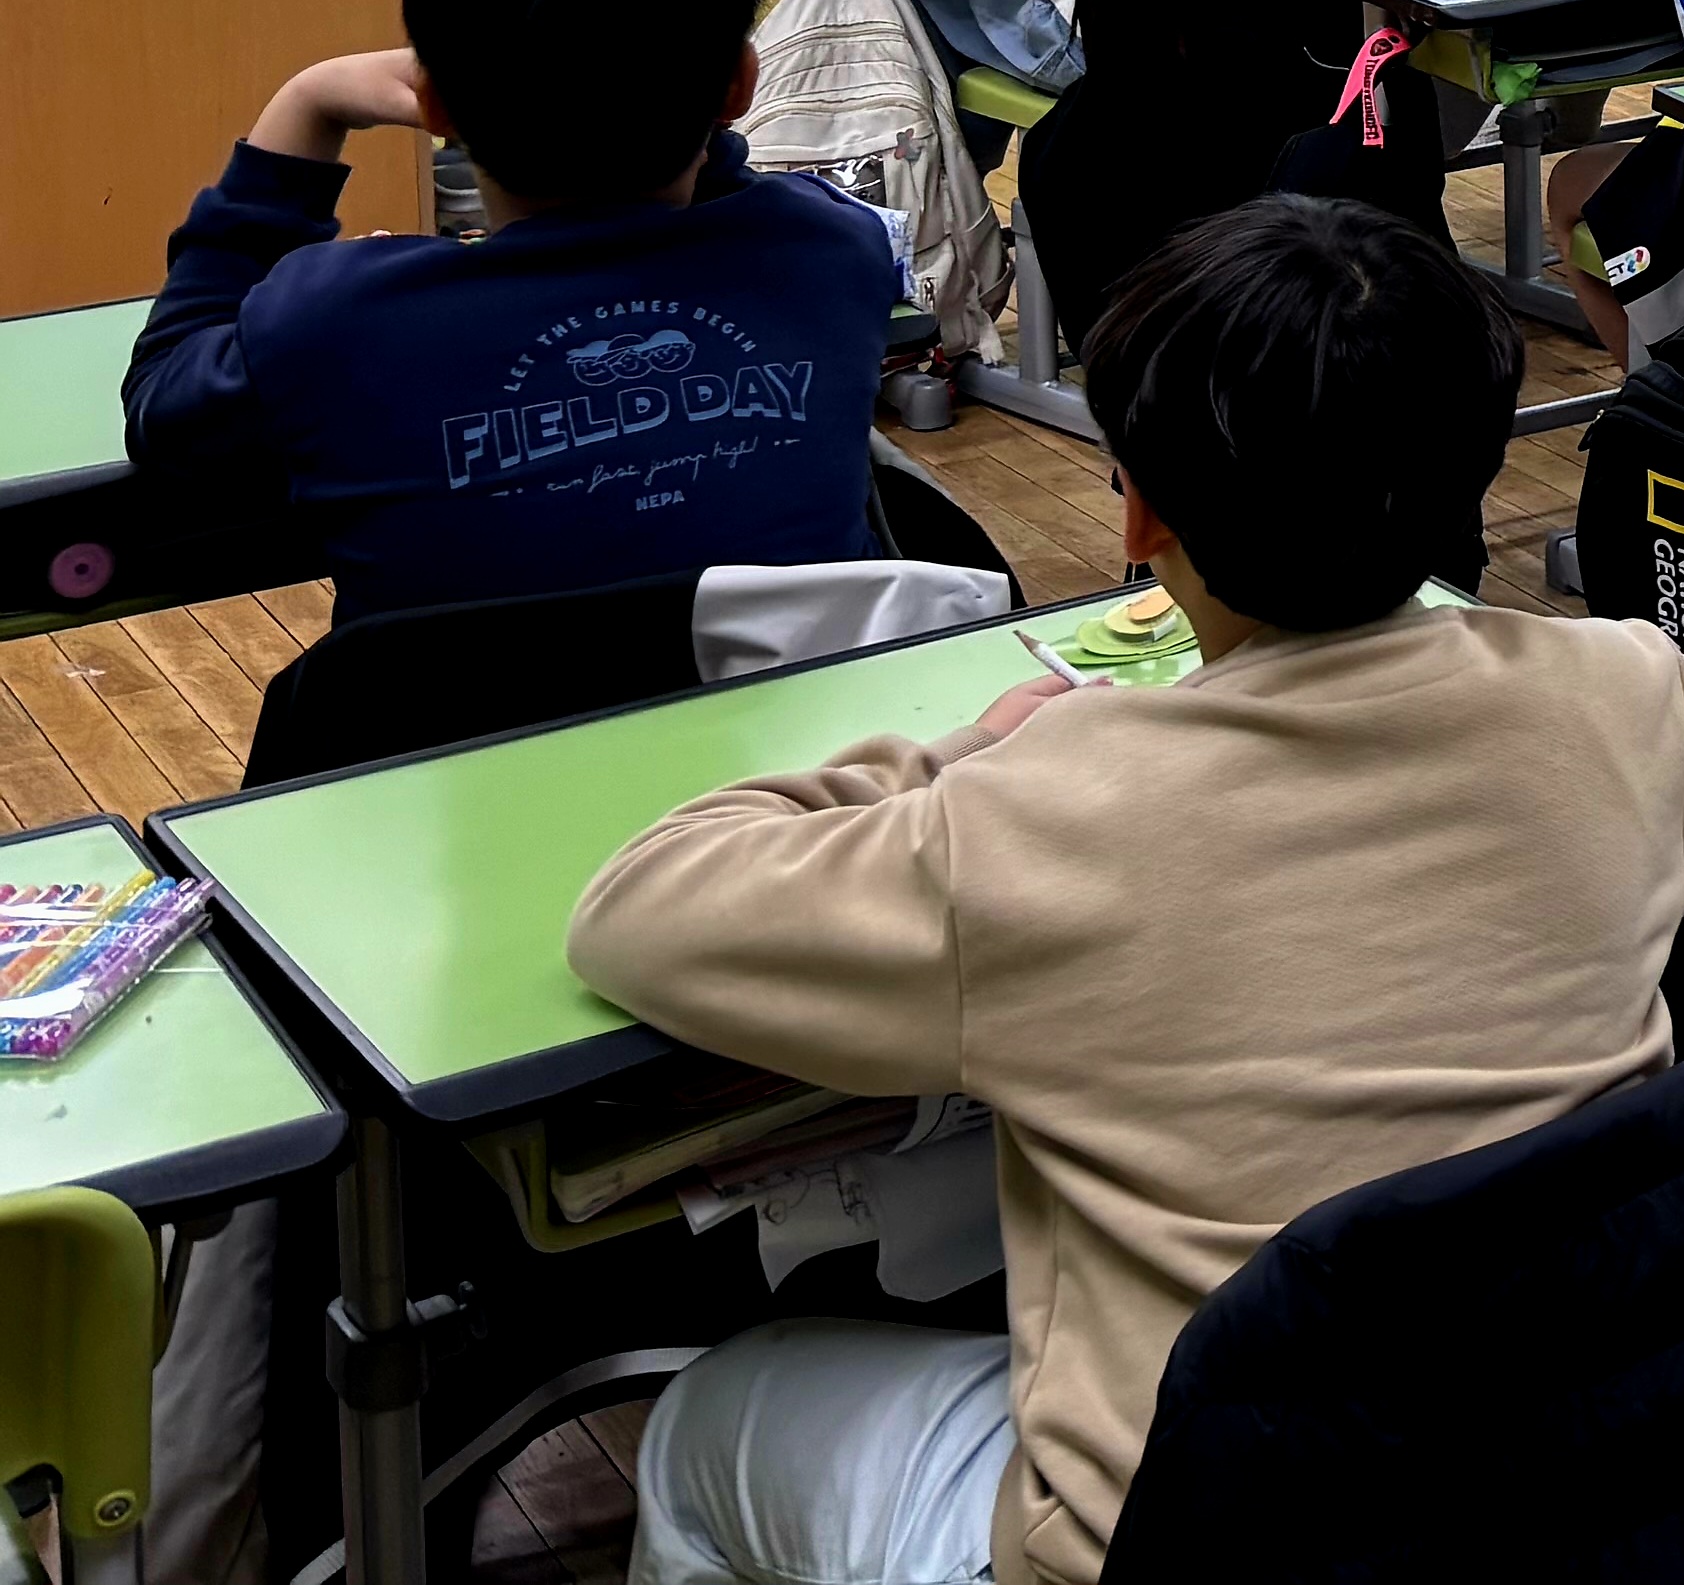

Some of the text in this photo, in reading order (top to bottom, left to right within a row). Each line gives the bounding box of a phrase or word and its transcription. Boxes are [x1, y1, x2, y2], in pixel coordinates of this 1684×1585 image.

[503, 300, 757, 392] LET THE GAMES BEGIN
[442, 361, 813, 489] FIELD DAY
[635, 490, 685, 511] NEPA
[1653, 538, 1679, 637] GEOGR
